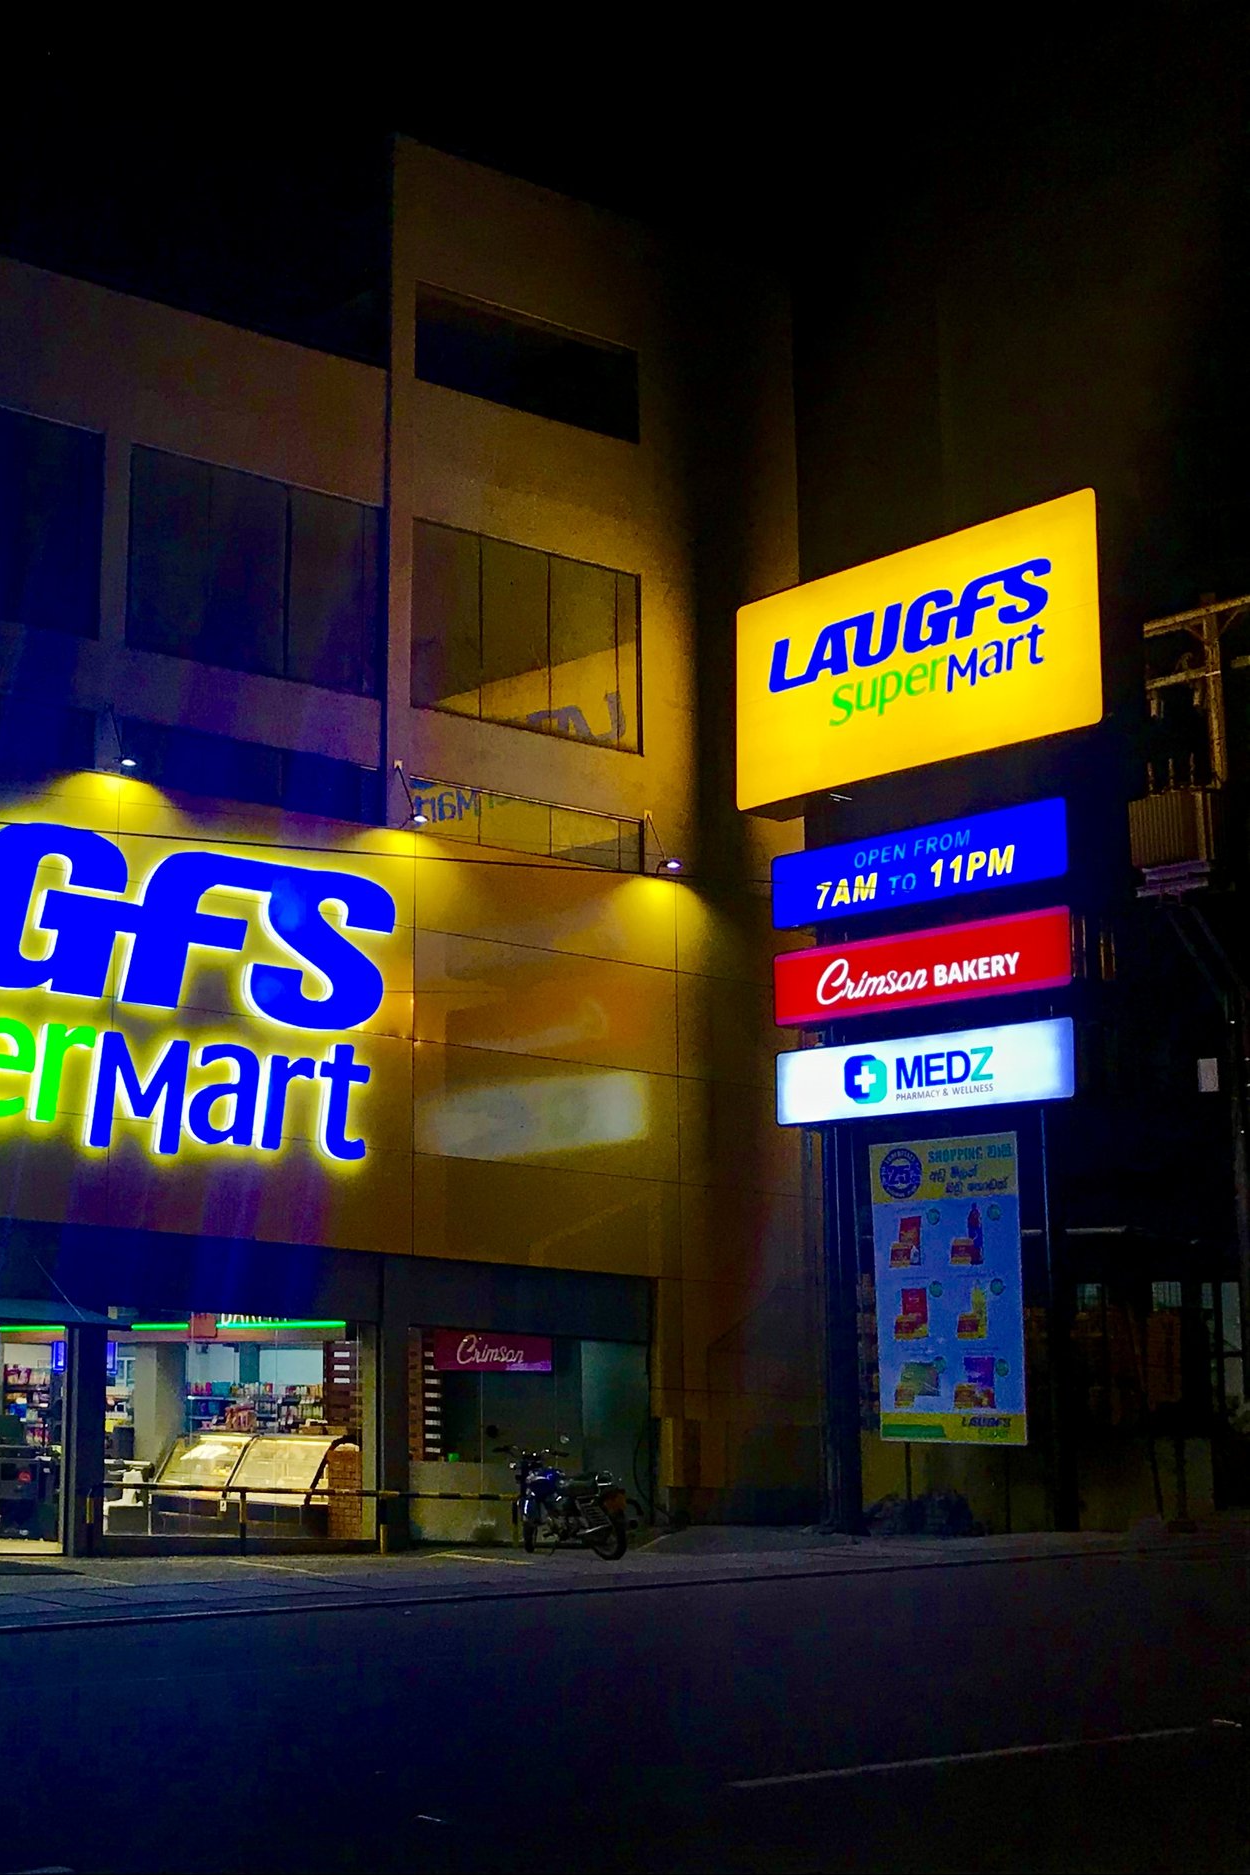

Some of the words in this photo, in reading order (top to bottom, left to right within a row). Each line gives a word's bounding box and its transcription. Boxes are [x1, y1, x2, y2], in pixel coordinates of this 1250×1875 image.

[768, 558, 1052, 693] LAUGFS
[854, 845, 906, 869] OPEN
[914, 829, 971, 857] FROM
[816, 872, 878, 910] 7AM
[888, 872, 917, 895] TO
[930, 845, 1015, 888] 11PM
[816, 958, 928, 1006] Crimson
[934, 952, 1020, 987] BAKERY
[896, 1045, 994, 1089] MEDZ
[895, 1089, 940, 1102] PHARMACY
[942, 1088, 949, 1096] &
[951, 1083, 994, 1096] WELLNESS
[456, 1334, 525, 1365] Crimson
